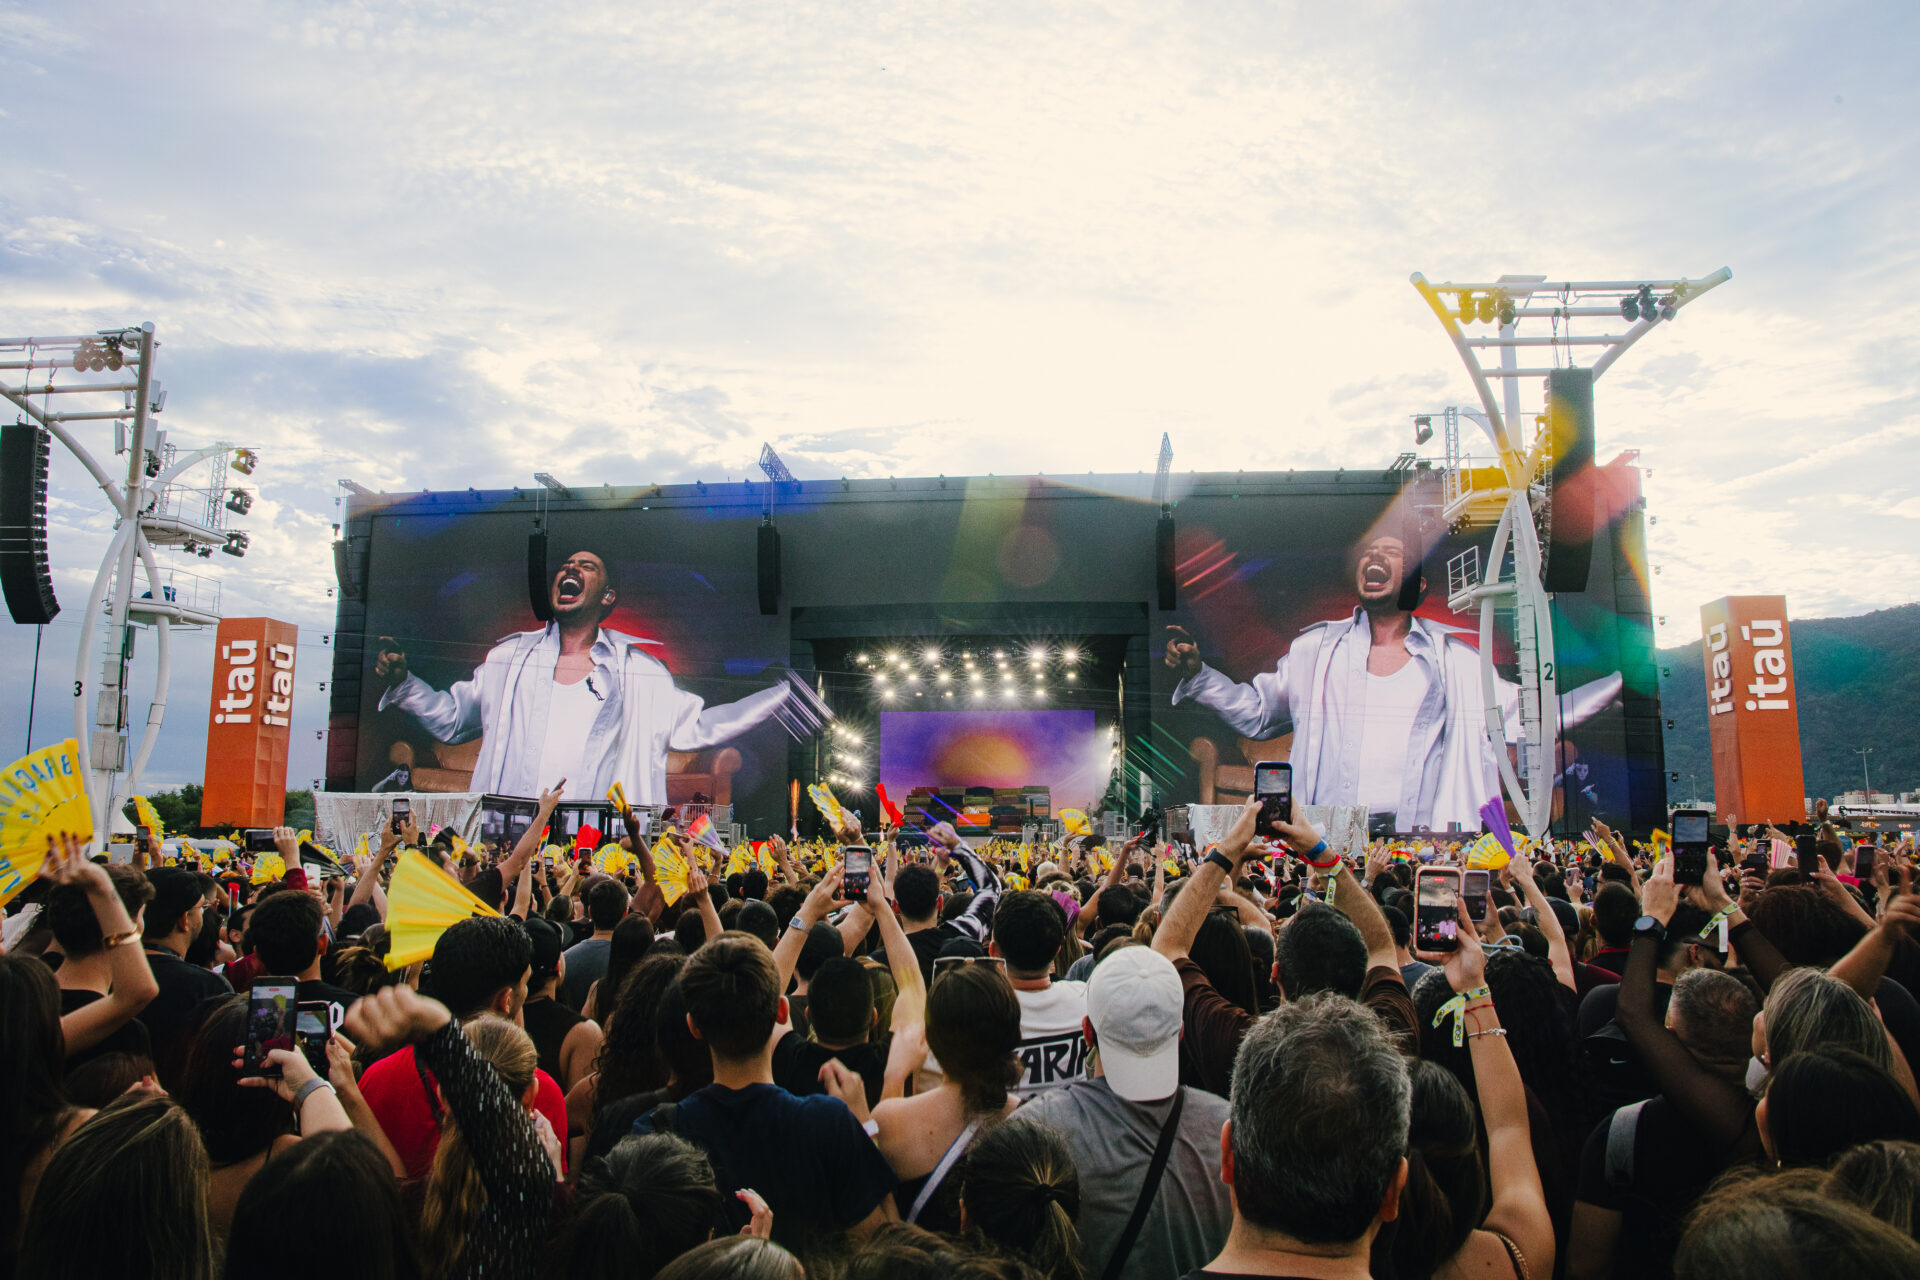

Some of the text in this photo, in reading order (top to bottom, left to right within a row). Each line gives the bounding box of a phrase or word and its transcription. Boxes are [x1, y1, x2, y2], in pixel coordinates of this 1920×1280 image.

[73, 680, 83, 697] 3
[215, 640, 257, 724] itaú
[263, 643, 294, 727] itaú
[1544, 662, 1554, 681] 2
[1705, 622, 1733, 716] itaú
[1741, 619, 1789, 711] itaú
